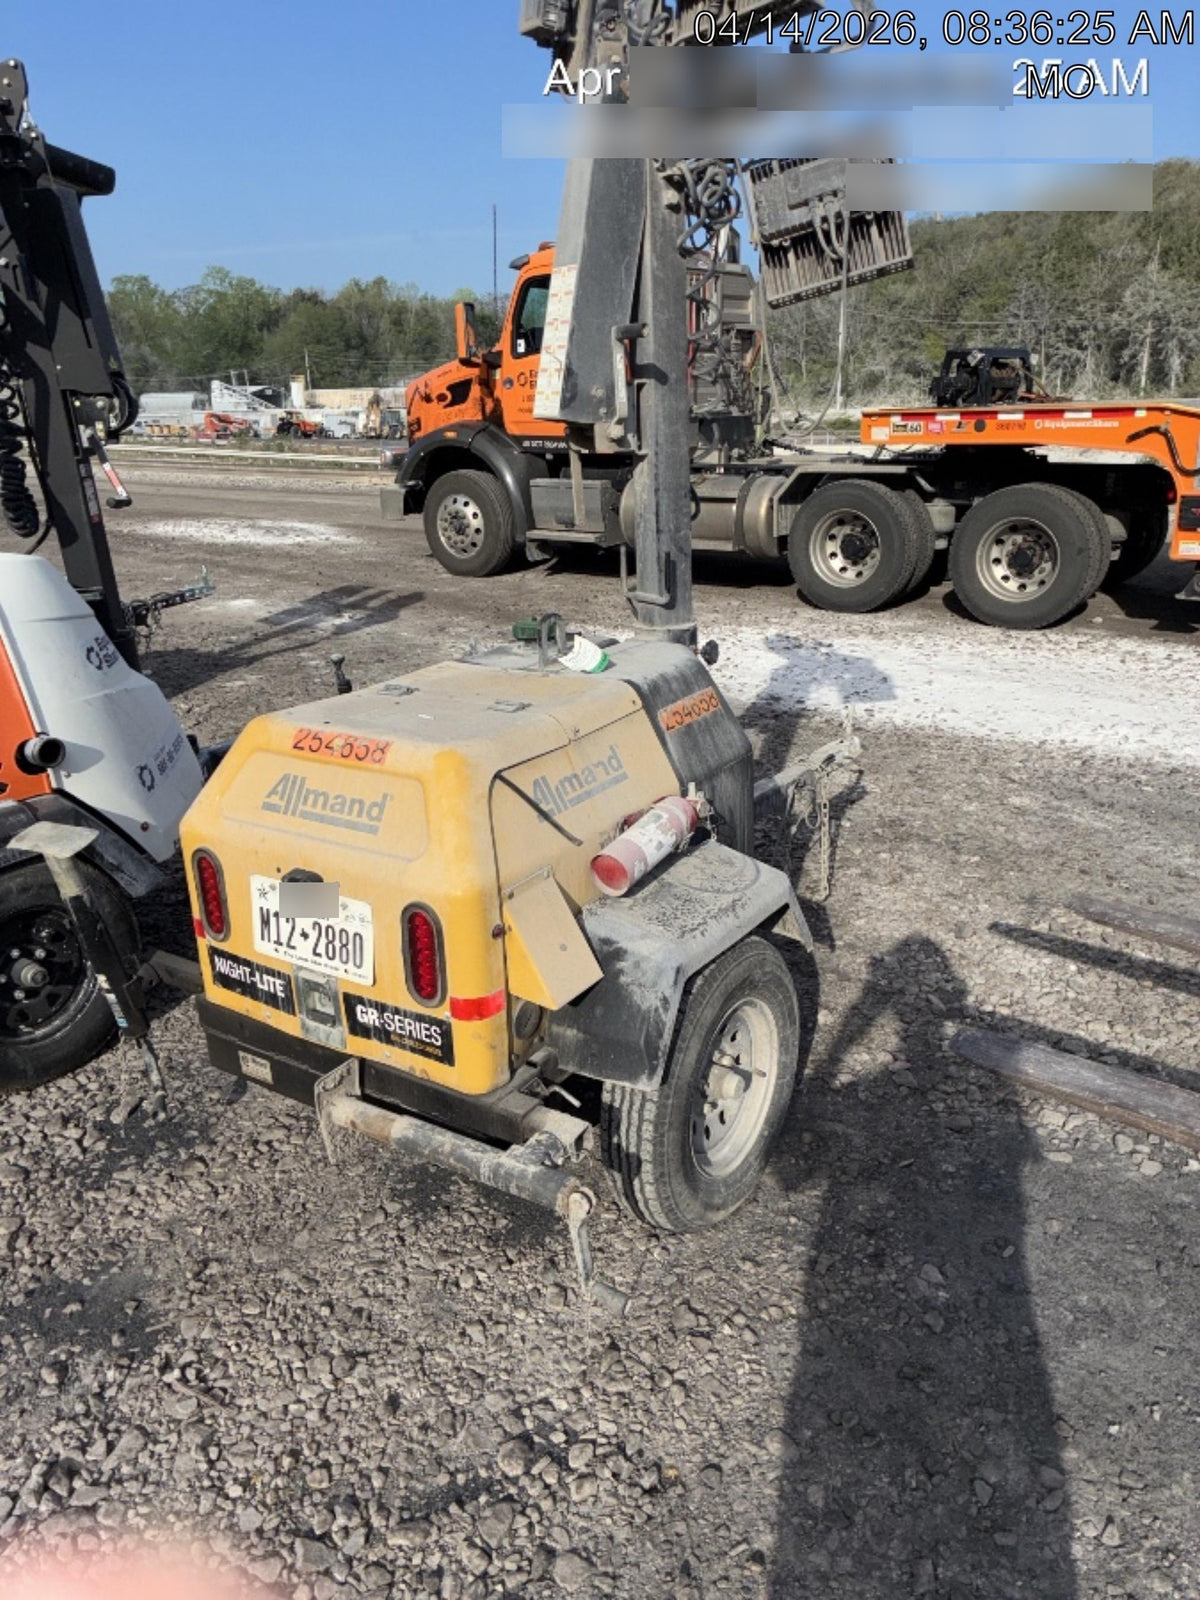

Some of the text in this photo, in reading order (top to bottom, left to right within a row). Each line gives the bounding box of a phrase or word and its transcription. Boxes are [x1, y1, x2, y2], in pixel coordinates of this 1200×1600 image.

[264, 773, 389, 823] Allmand
[530, 747, 624, 818] Allmand
[214, 954, 286, 998] NIGHT-LITE
[355, 1003, 442, 1046] GR-SERIES
